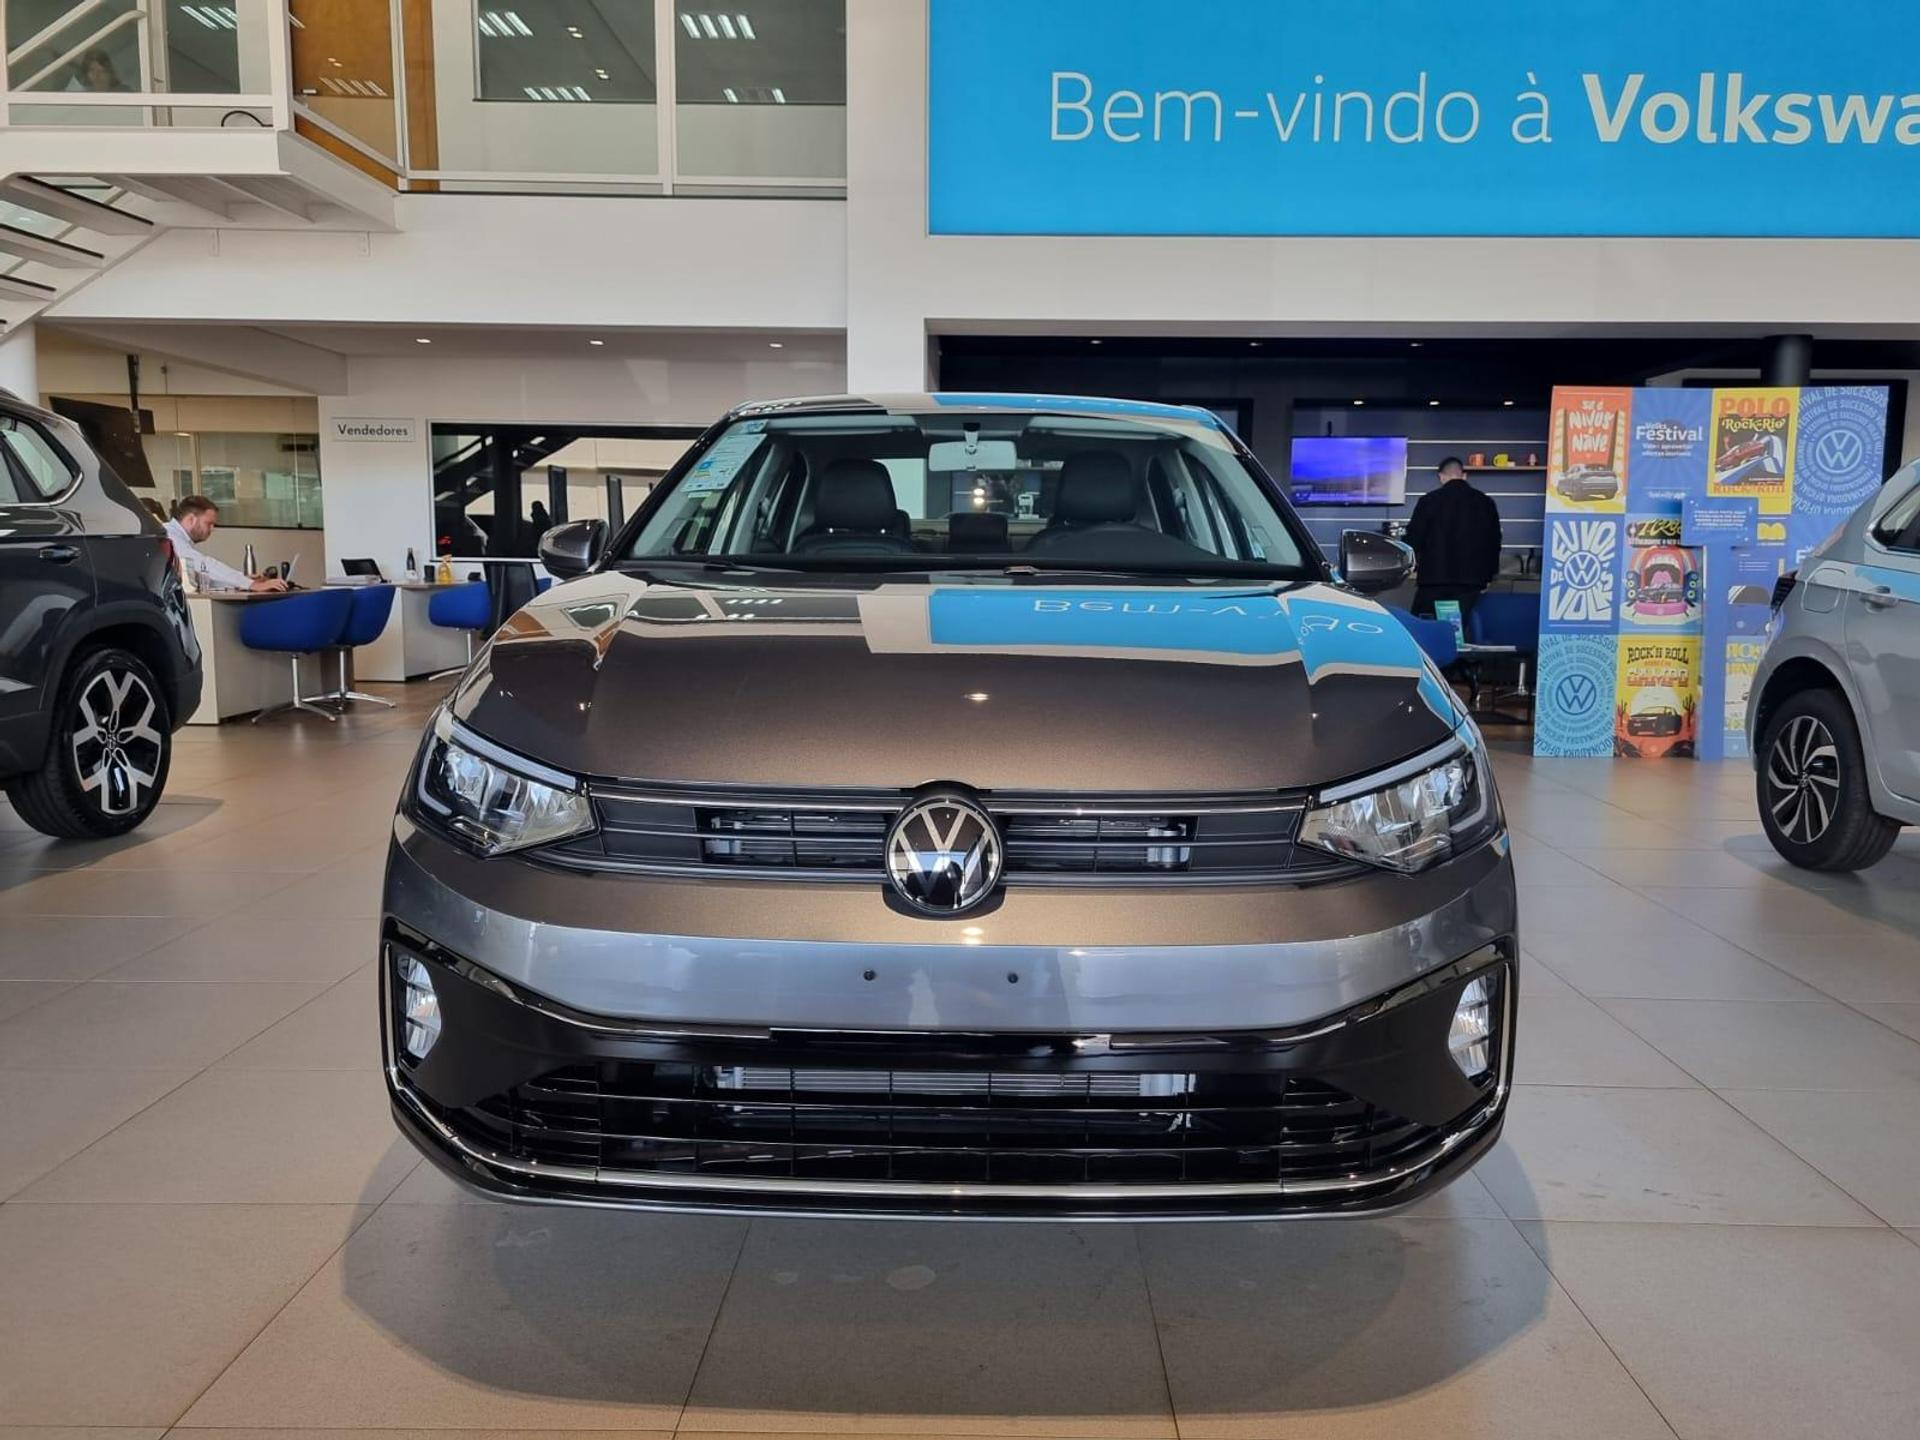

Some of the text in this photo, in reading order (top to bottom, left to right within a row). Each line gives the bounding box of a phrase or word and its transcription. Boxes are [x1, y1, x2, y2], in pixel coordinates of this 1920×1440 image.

[1051, 72, 1479, 144] Bem-vindo
[1512, 72, 1552, 144] à
[1719, 397, 1790, 417] POLO
[337, 423, 408, 437] Vendedores
[1635, 425, 1703, 441] Festival
[1665, 647, 1689, 664] ROLL
